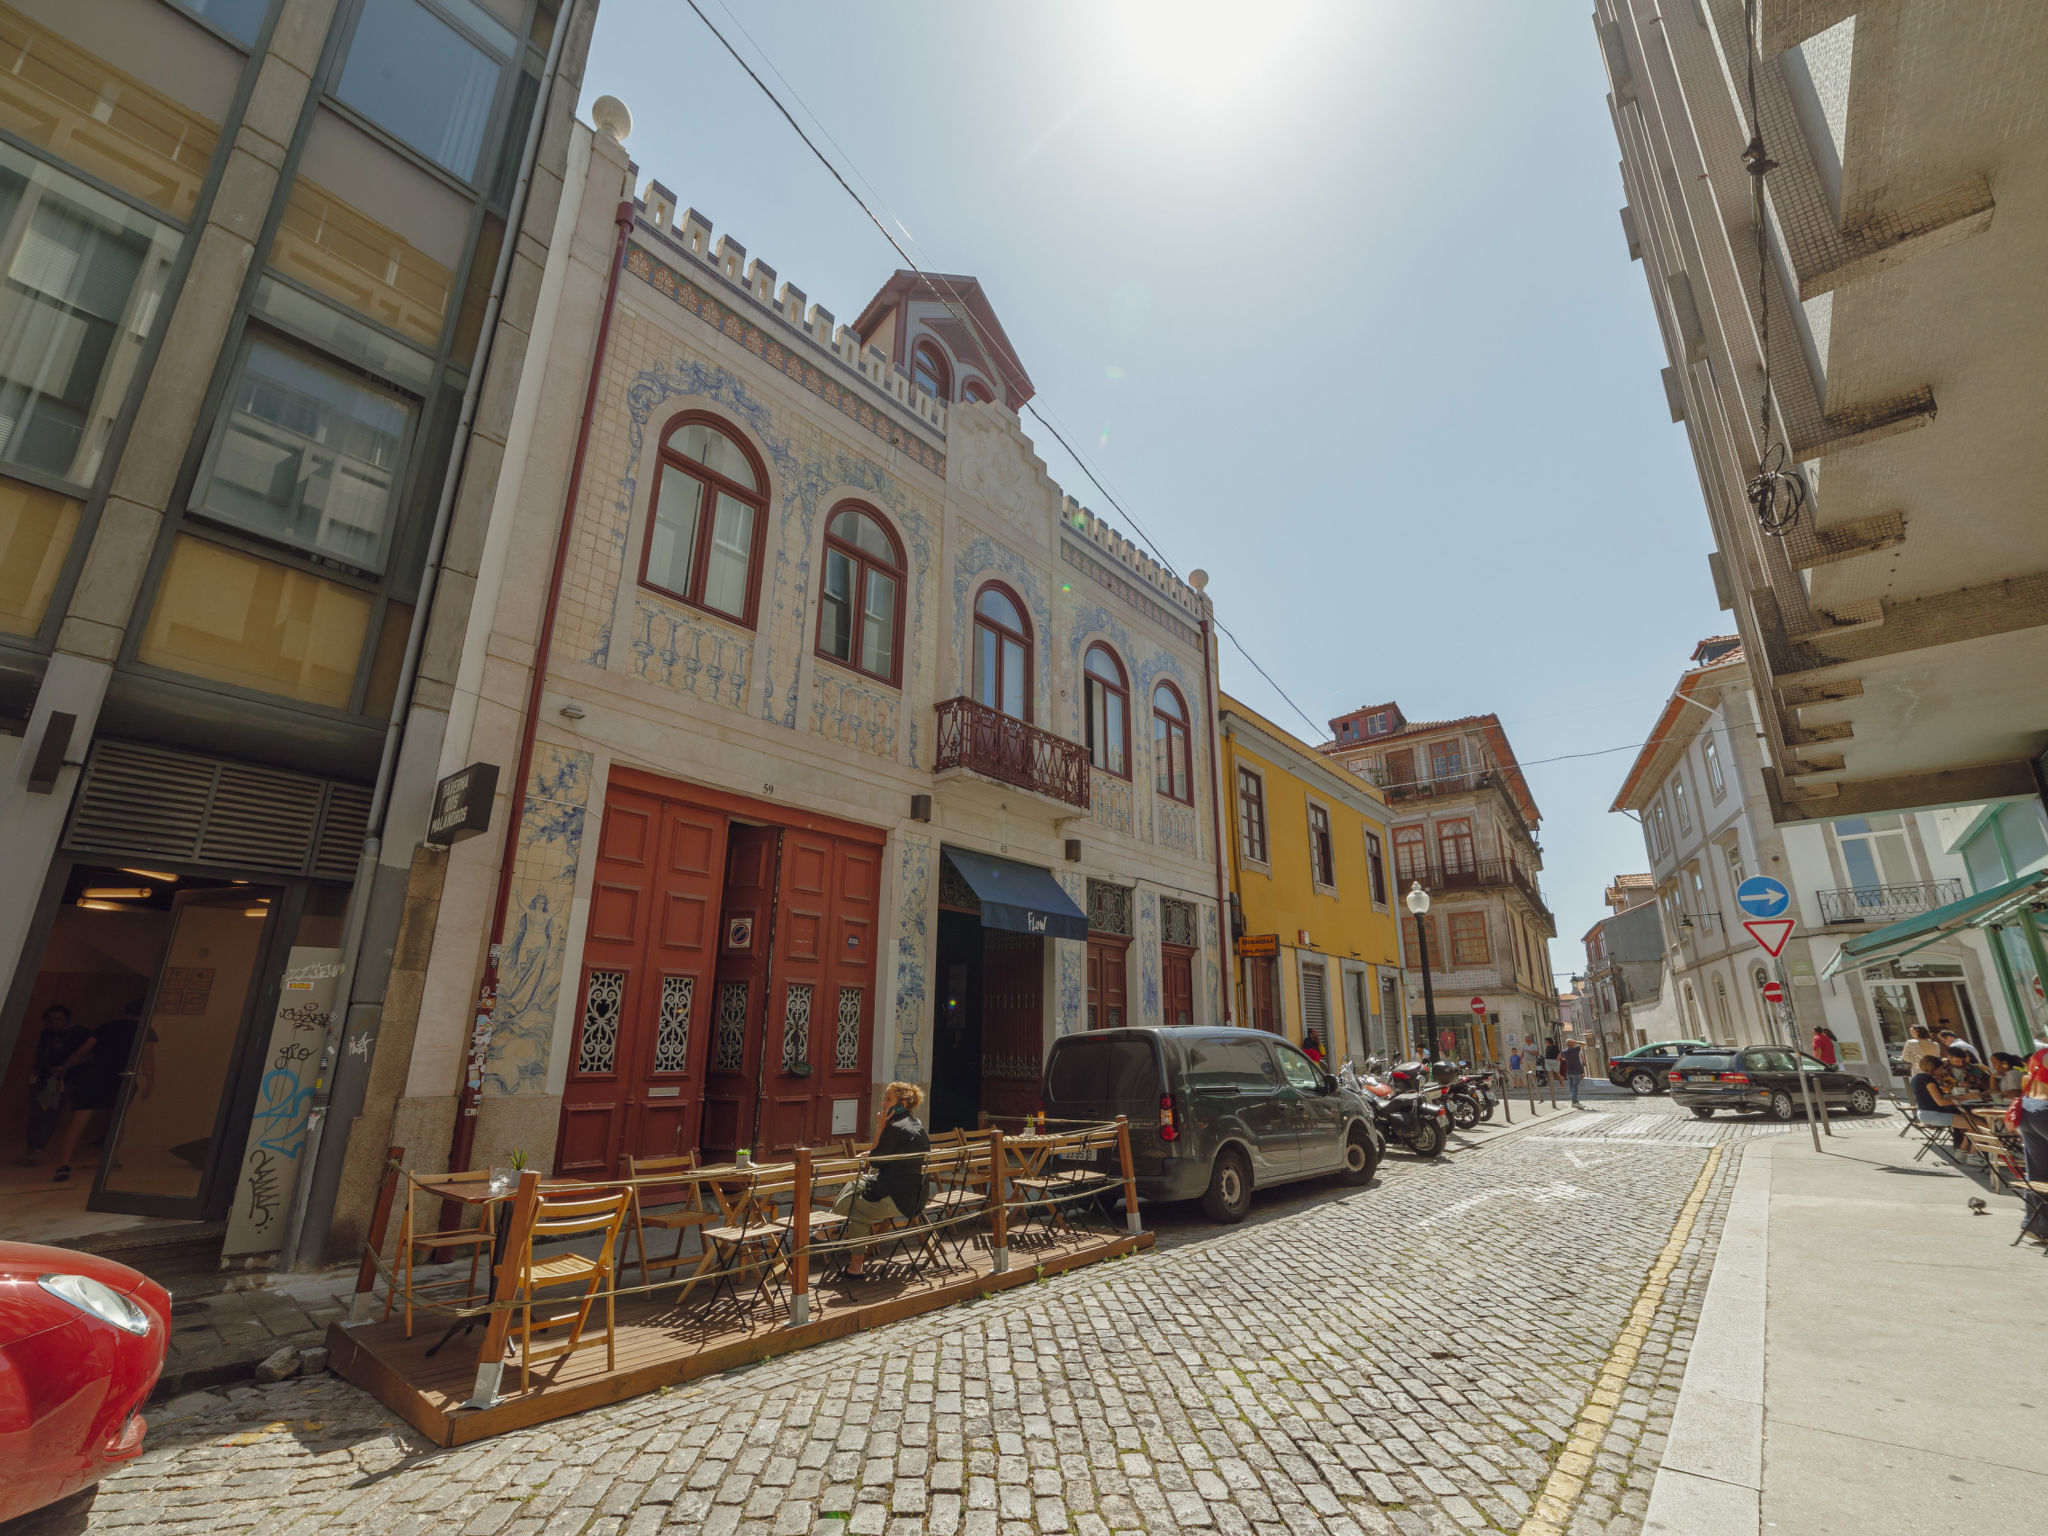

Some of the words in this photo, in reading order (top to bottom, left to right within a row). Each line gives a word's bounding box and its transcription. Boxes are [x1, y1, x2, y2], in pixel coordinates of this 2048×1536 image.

[443, 774, 470, 799] TAVERNA
[762, 783, 774, 795] 59
[430, 806, 468, 834] MALANDROS
